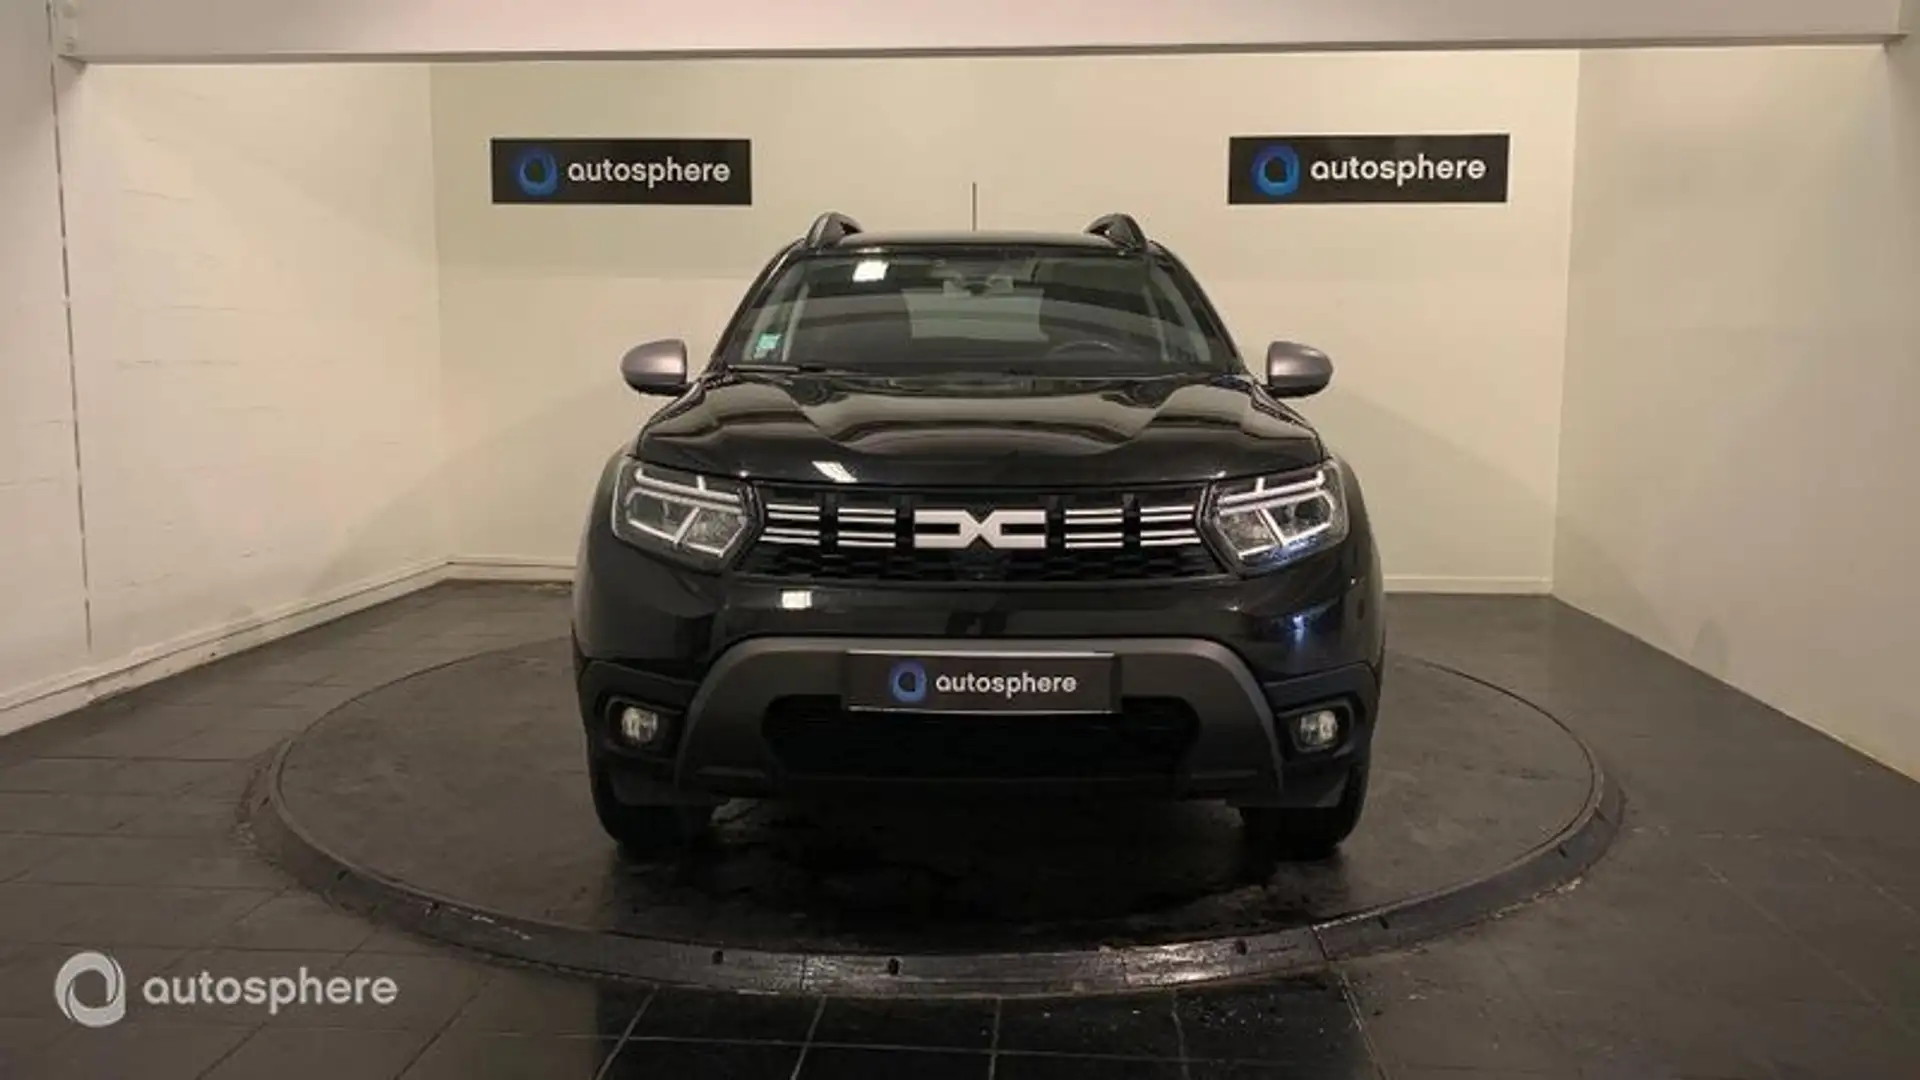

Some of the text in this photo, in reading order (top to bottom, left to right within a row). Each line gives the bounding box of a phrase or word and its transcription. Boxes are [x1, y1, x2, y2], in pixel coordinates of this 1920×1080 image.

[567, 154, 731, 188] autosphere
[1310, 152, 1487, 187] autosphere
[935, 666, 1078, 698] autosphere
